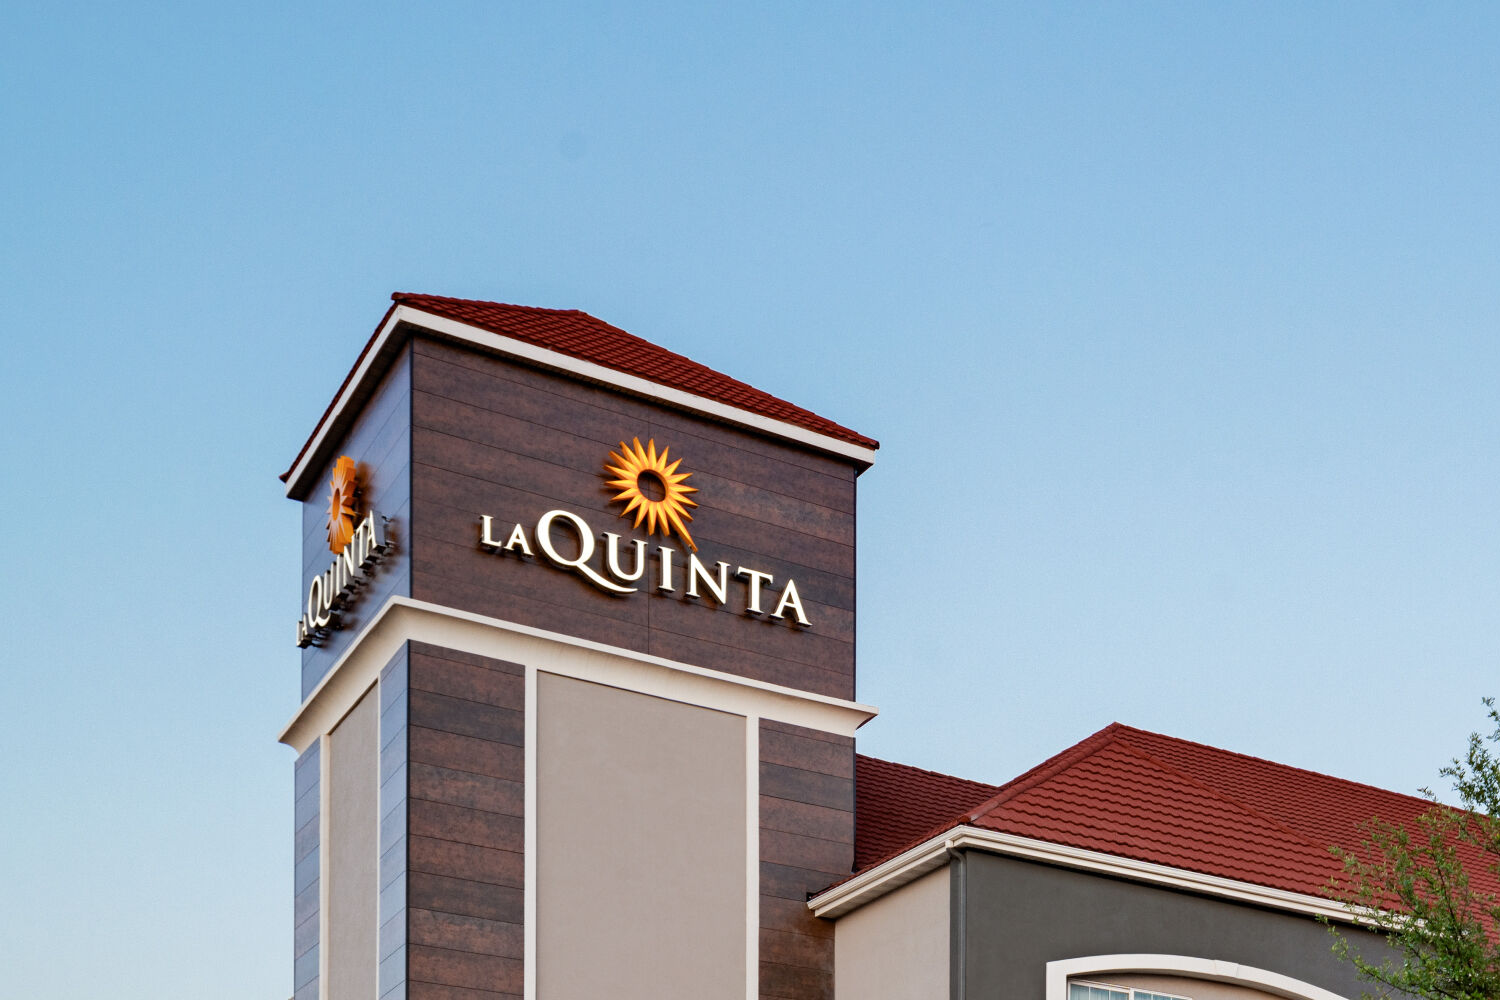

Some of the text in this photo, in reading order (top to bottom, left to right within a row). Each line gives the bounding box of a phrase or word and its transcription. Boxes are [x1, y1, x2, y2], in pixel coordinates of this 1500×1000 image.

[308, 510, 382, 628] QUINTA
[480, 509, 812, 627] LA QUINTA
